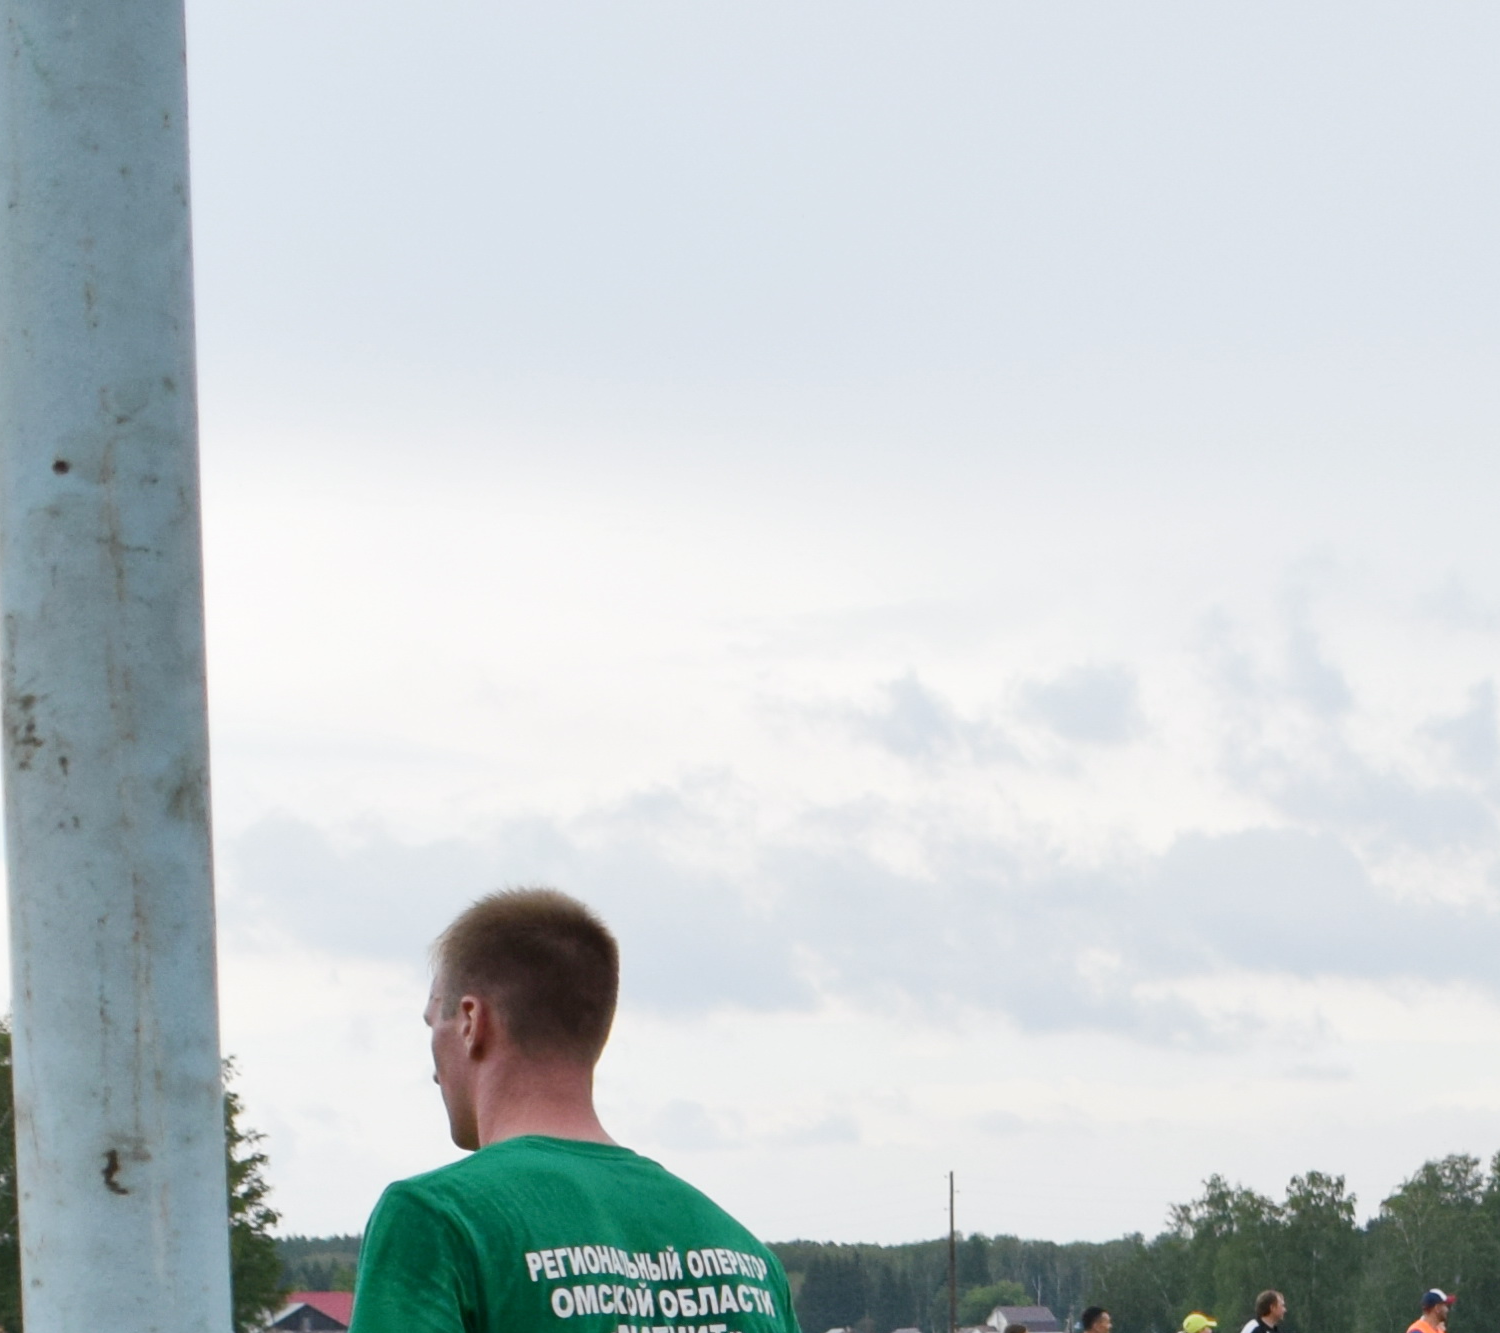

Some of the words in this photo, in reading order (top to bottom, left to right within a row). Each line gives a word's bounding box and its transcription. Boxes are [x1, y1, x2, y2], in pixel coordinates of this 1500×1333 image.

[525, 1245, 683, 1282] РЕГИОНАЛЬНЫЙ
[687, 1248, 767, 1281] ОПЕРАТОР
[551, 1282, 655, 1318] ОМСКОЙ
[659, 1284, 775, 1318] ОБЛАСТИ
